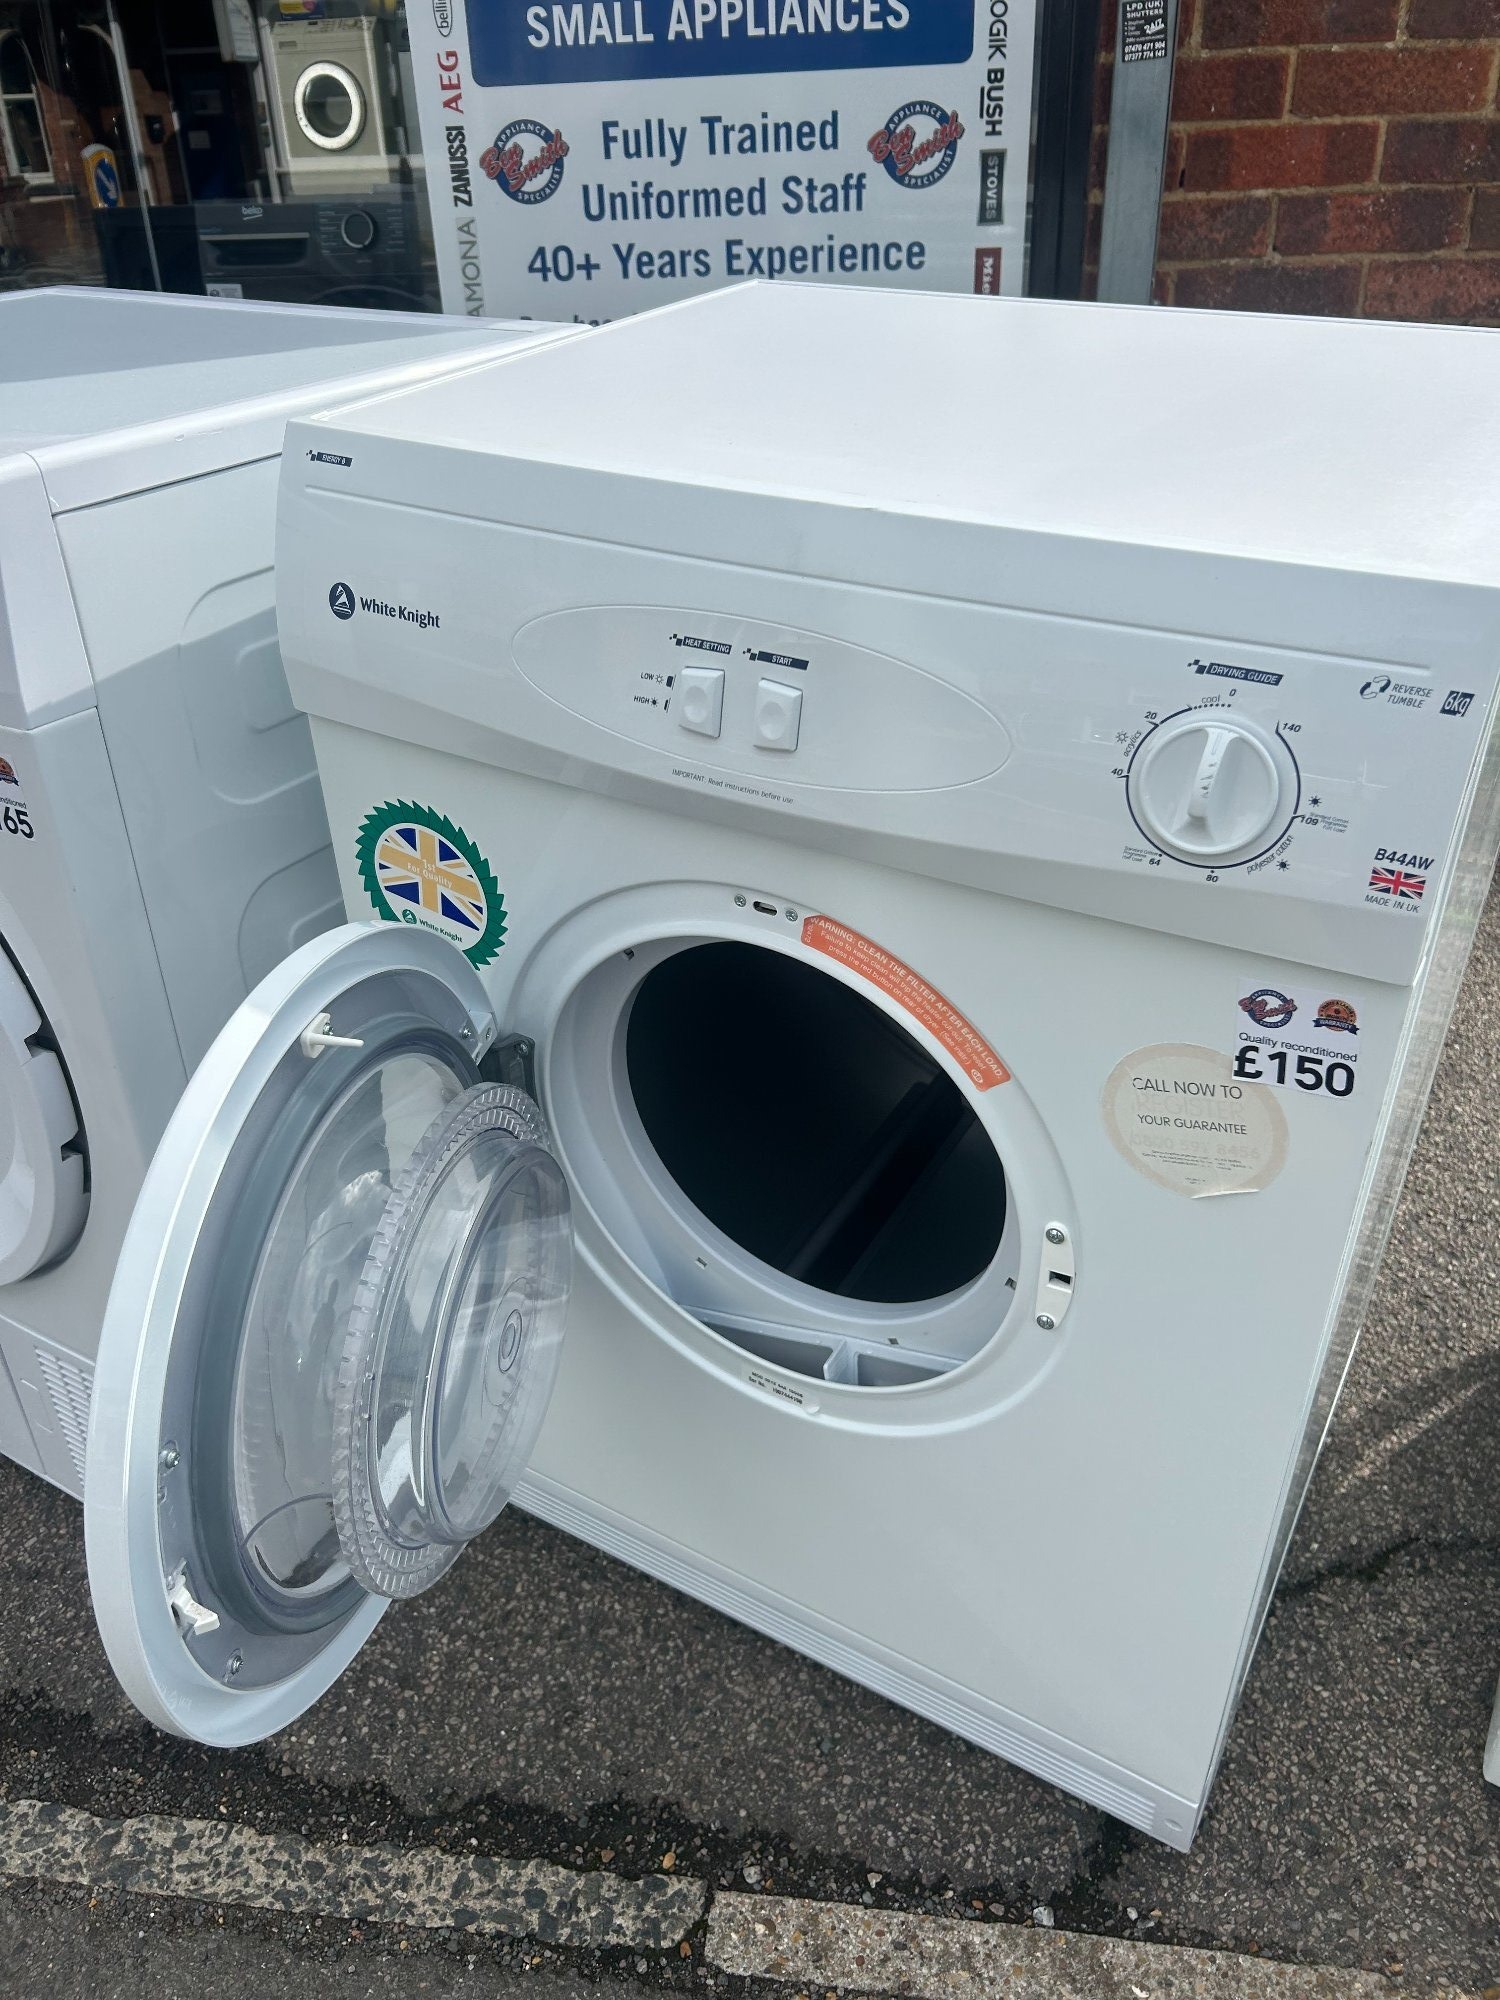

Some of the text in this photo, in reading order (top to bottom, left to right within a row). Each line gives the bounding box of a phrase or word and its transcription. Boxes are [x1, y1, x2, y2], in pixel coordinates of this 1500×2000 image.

[435, 0, 449, 29] belli
[1126, 0, 1164, 11] LPD (UK)
[1126, 8, 1164, 18] SHUTTERS
[526, 0, 910, 48] SMALL APPLIANCES
[988, 0, 1008, 61] OGIK
[437, 50, 464, 114] AEG
[985, 67, 1005, 136] BUSH
[888, 104, 942, 131] APPLIANCE
[497, 122, 547, 147] APPLIANCE
[601, 109, 839, 167] Fully Trained
[867, 124, 916, 163] Ben
[895, 109, 966, 176] Smith
[445, 125, 473, 207] ZANUSSI
[479, 141, 524, 180] Ben
[505, 128, 570, 192] Smith
[903, 150, 953, 186] SPECIALIST
[517, 167, 561, 201] SPECIALIST
[582, 172, 867, 222] Uniformed Staff
[986, 155, 999, 219] STOVES
[457, 218, 485, 317] AMONA
[527, 234, 926, 282] 40+ Years Experience
[321, 454, 341, 464] ENERGY
[360, 596, 441, 629] White Knight
[685, 637, 730, 653] HEAT SETTING
[771, 655, 793, 666] START
[640, 672, 654, 681] LOW
[1210, 665, 1279, 684] DRYING GUIDE
[633, 695, 650, 705] HIGH
[1201, 694, 1221, 704] cool
[1228, 688, 1237, 697] 0
[1387, 694, 1426, 709] TUMBLE
[1391, 683, 1434, 698] REVERSE
[1144, 711, 1157, 720] 20
[1282, 722, 1301, 732] 140
[1123, 730, 1142, 758] acrylics
[1111, 768, 1123, 776] 40
[708, 777, 724, 788] Read
[724, 781, 760, 796] instructions
[761, 789, 781, 801] before
[782, 796, 794, 804] use
[0, 806, 35, 839] 65
[1300, 815, 1319, 825] 109
[1275, 834, 1294, 857] cotton
[1373, 847, 1435, 870] B44AW
[422, 859, 436, 873] 1st
[1148, 858, 1161, 866] 64
[1246, 852, 1276, 875] polyester
[407, 863, 453, 889] For Quality
[1205, 874, 1218, 883] 80
[1364, 894, 1420, 913] MADE IN UK
[419, 918, 463, 943] White Knight
[810, 917, 855, 944] WARNING:
[857, 940, 889, 964] CLEAN
[889, 960, 907, 977] THE
[906, 975, 936, 1002] FILTER
[936, 1002, 962, 1028] AFTER
[961, 1028, 983, 1052] EACH
[828, 945, 847, 958] press
[848, 955, 860, 966] the
[860, 963, 872, 974] red
[872, 970, 893, 990] button
[893, 988, 903, 997] on
[902, 995, 917, 1009] rear
[915, 1007, 924, 1015] of
[940, 1030, 955, 1047] (See
[820, 930, 844, 947] Failure
[845, 943, 852, 951] to
[852, 949, 870, 963] keep
[870, 960, 889, 975] clean
[889, 973, 901, 985] will
[900, 981, 911, 993] trip
[911, 991, 922, 1002] the
[922, 1000, 942, 1021] heater
[964, 1043, 972, 1053] To
[971, 1053, 987, 1070] reset
[1238, 1031, 1358, 1063] Quality reconditioned
[1233, 1045, 1355, 1097] £150
[1132, 1076, 1243, 1100] CALL NOW TO
[1137, 1113, 1248, 1136] YOUR GUARANTEE
